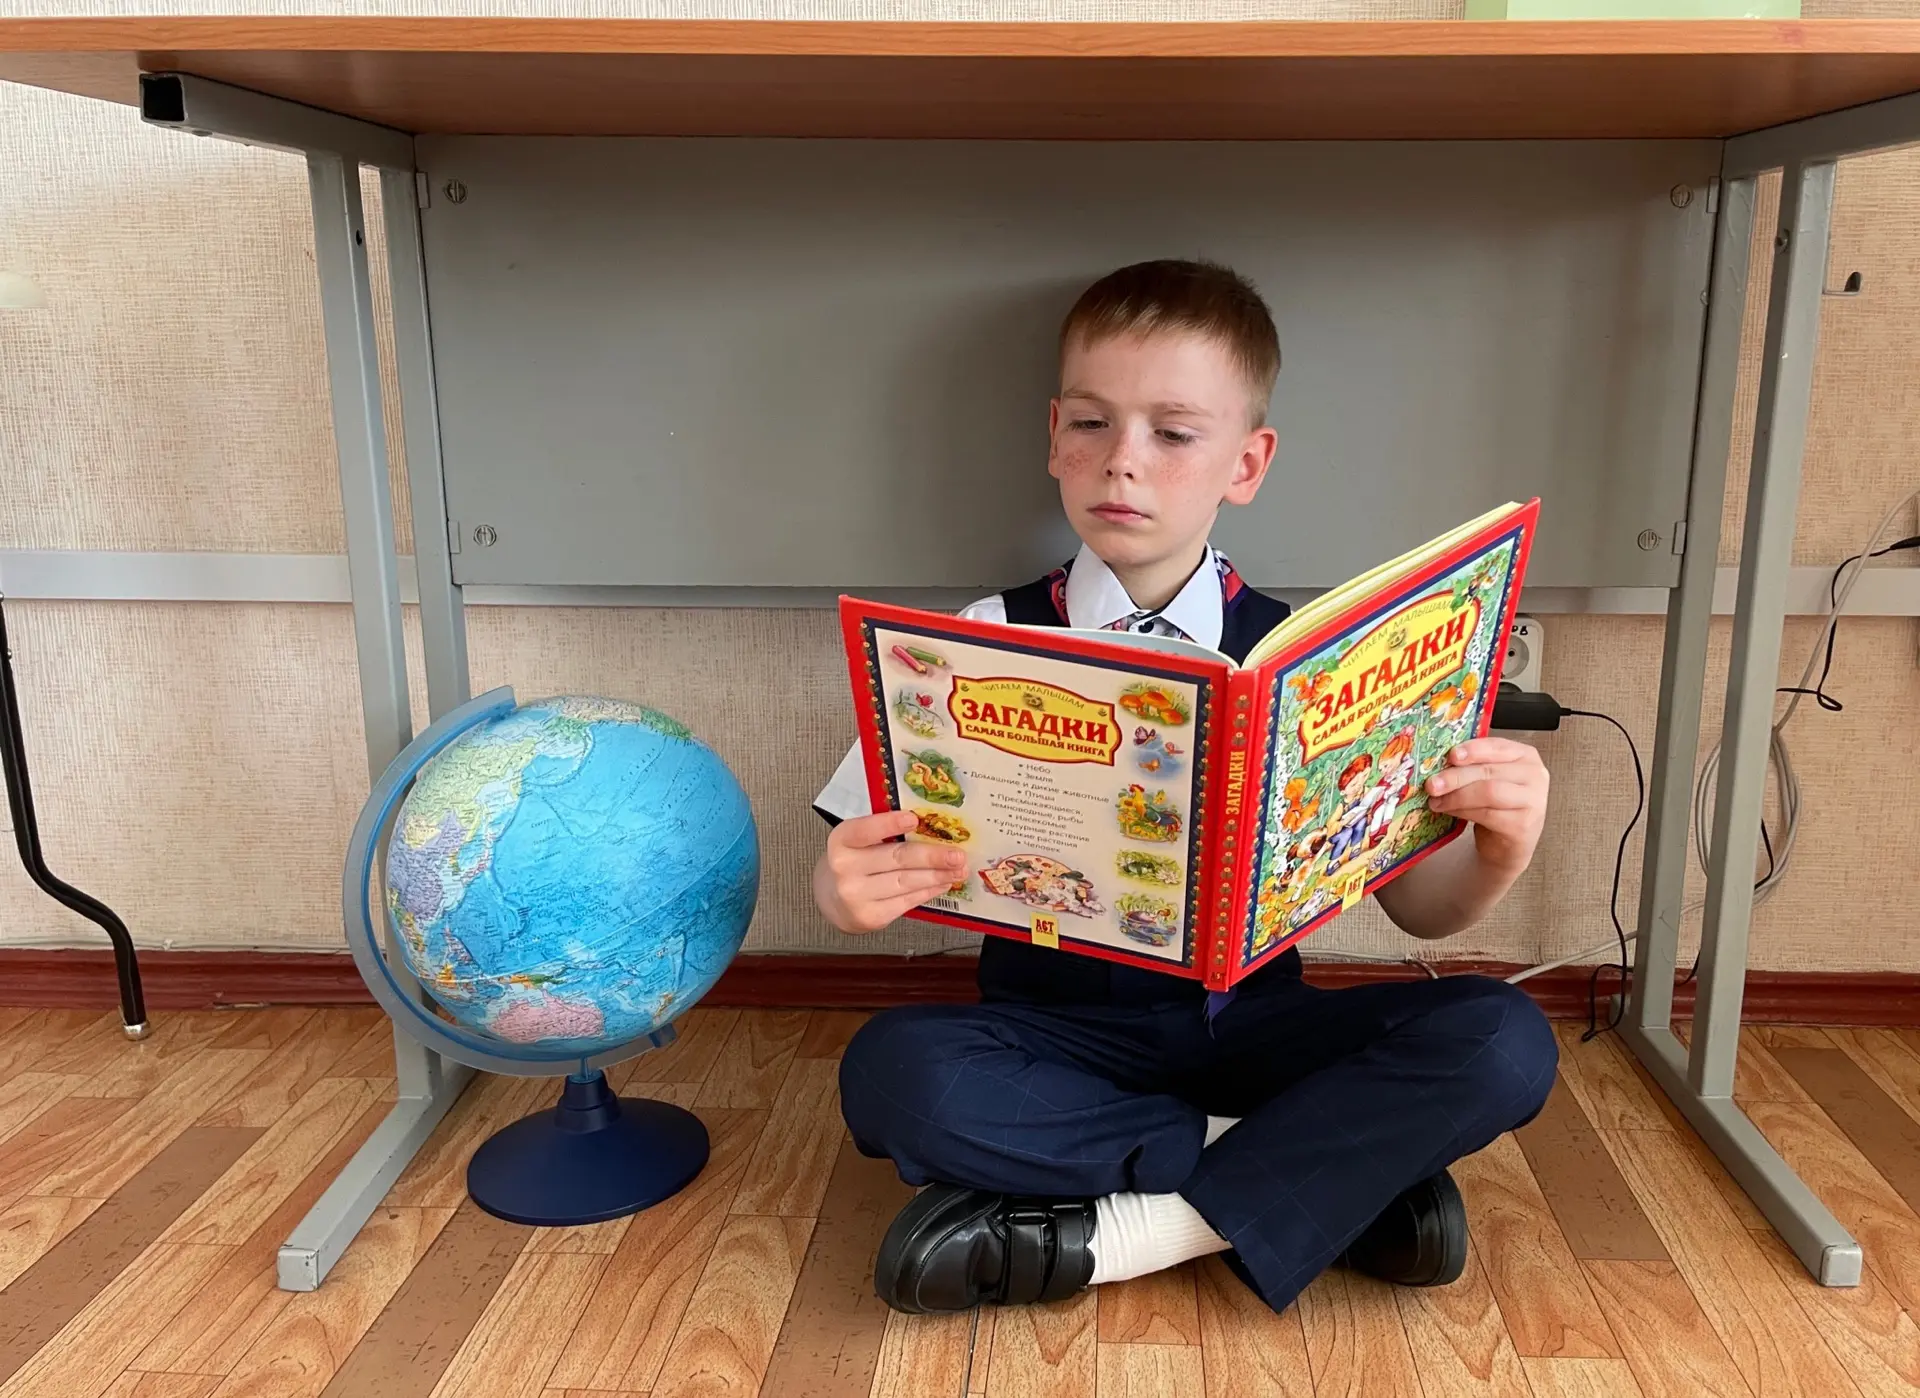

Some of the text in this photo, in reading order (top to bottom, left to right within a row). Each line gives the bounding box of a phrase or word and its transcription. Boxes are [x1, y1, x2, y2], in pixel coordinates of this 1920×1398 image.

[1343, 628, 1388, 668] ЧИТАЕМ
[1312, 610, 1469, 729] ЗАГАДКИ
[982, 682, 1085, 710] ЧИТАЕМ МАЛЫШАМ
[1313, 650, 1458, 746] САМАЯ БОЛЬШАЯ КНИГА
[961, 699, 1109, 745] ЗАГАДКИ
[965, 724, 1106, 757] САМАЯ БОЛЬШАЯ КНИГА
[1025, 773, 1054, 783] Земля
[1026, 763, 1051, 774] Небо
[970, 771, 1021, 786] Домашние
[1031, 783, 1060, 794] дикие
[1062, 789, 1110, 803] животные
[1225, 750, 1247, 815] ЗАГАДКИ
[997, 793, 1084, 816] Пресмыкающиеся,
[1025, 790, 1056, 801] Птицы
[991, 801, 1084, 825] земноводные, рыбы
[1015, 814, 1067, 829] Насекомые
[994, 818, 1090, 843] Культурные растения
[1006, 829, 1078, 849] Дикие растения
[1023, 841, 1061, 853] Человек
